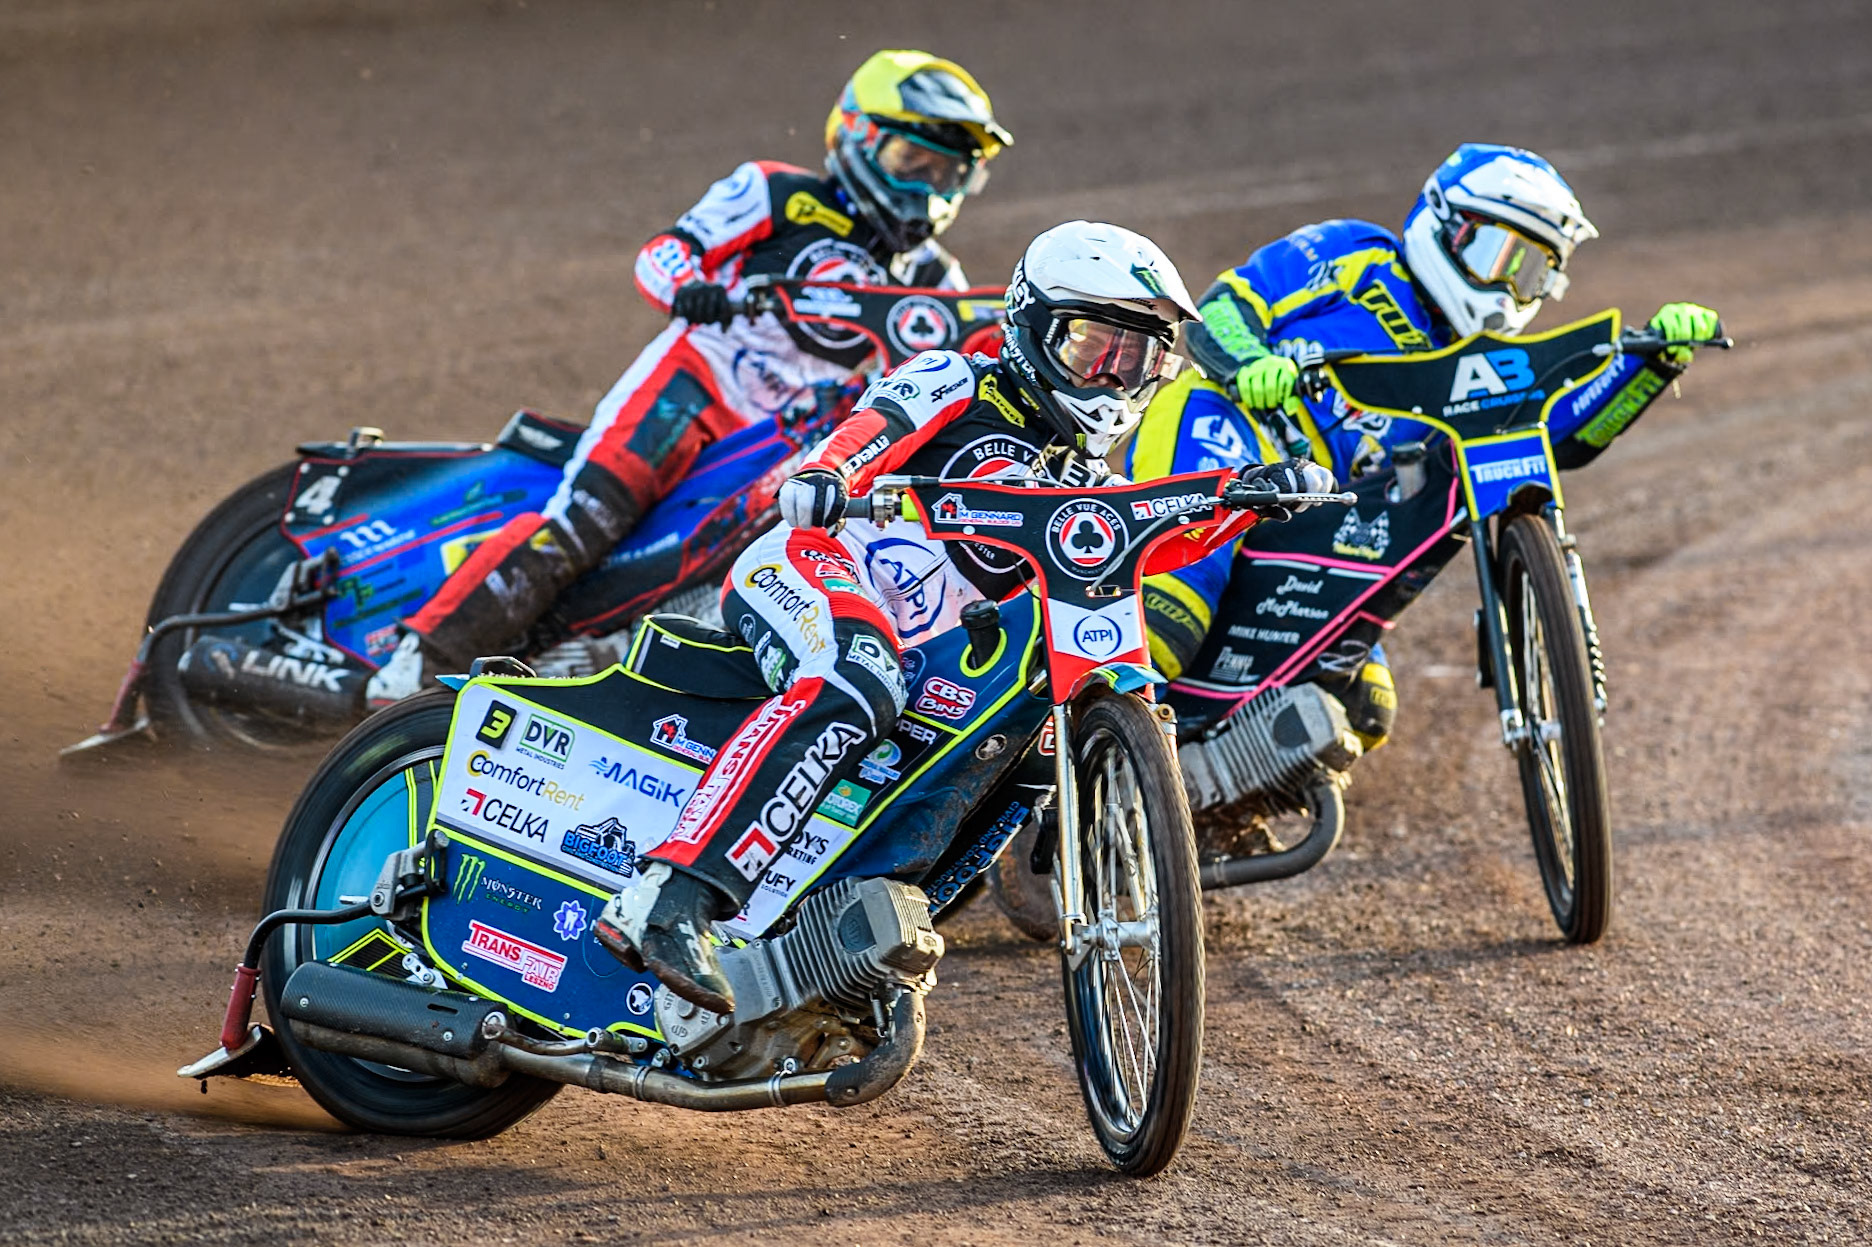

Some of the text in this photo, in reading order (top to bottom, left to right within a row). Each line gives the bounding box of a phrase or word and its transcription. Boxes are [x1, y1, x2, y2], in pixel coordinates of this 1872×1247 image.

[1449, 348, 1535, 403] AB
[972, 442, 1015, 462] BELLE
[295, 475, 342, 514] 4
[1153, 494, 1212, 516] CELKA
[971, 511, 1021, 521] GENNARD
[1051, 503, 1121, 534] BELLE VUE ACES
[1082, 629, 1113, 644] ATPI
[919, 697, 966, 716] BINS
[926, 682, 974, 706] CBS
[481, 709, 510, 739] 3
[525, 720, 570, 756] DVR
[896, 719, 938, 745] PER
[483, 798, 550, 843] CELKA
[564, 831, 628, 869] BIGFOOT
[928, 806, 1030, 914] BIGFOO
[481, 876, 543, 911] MONSTER
[470, 922, 563, 985] TRANS FAIR
[524, 973, 555, 991] LESZNO
